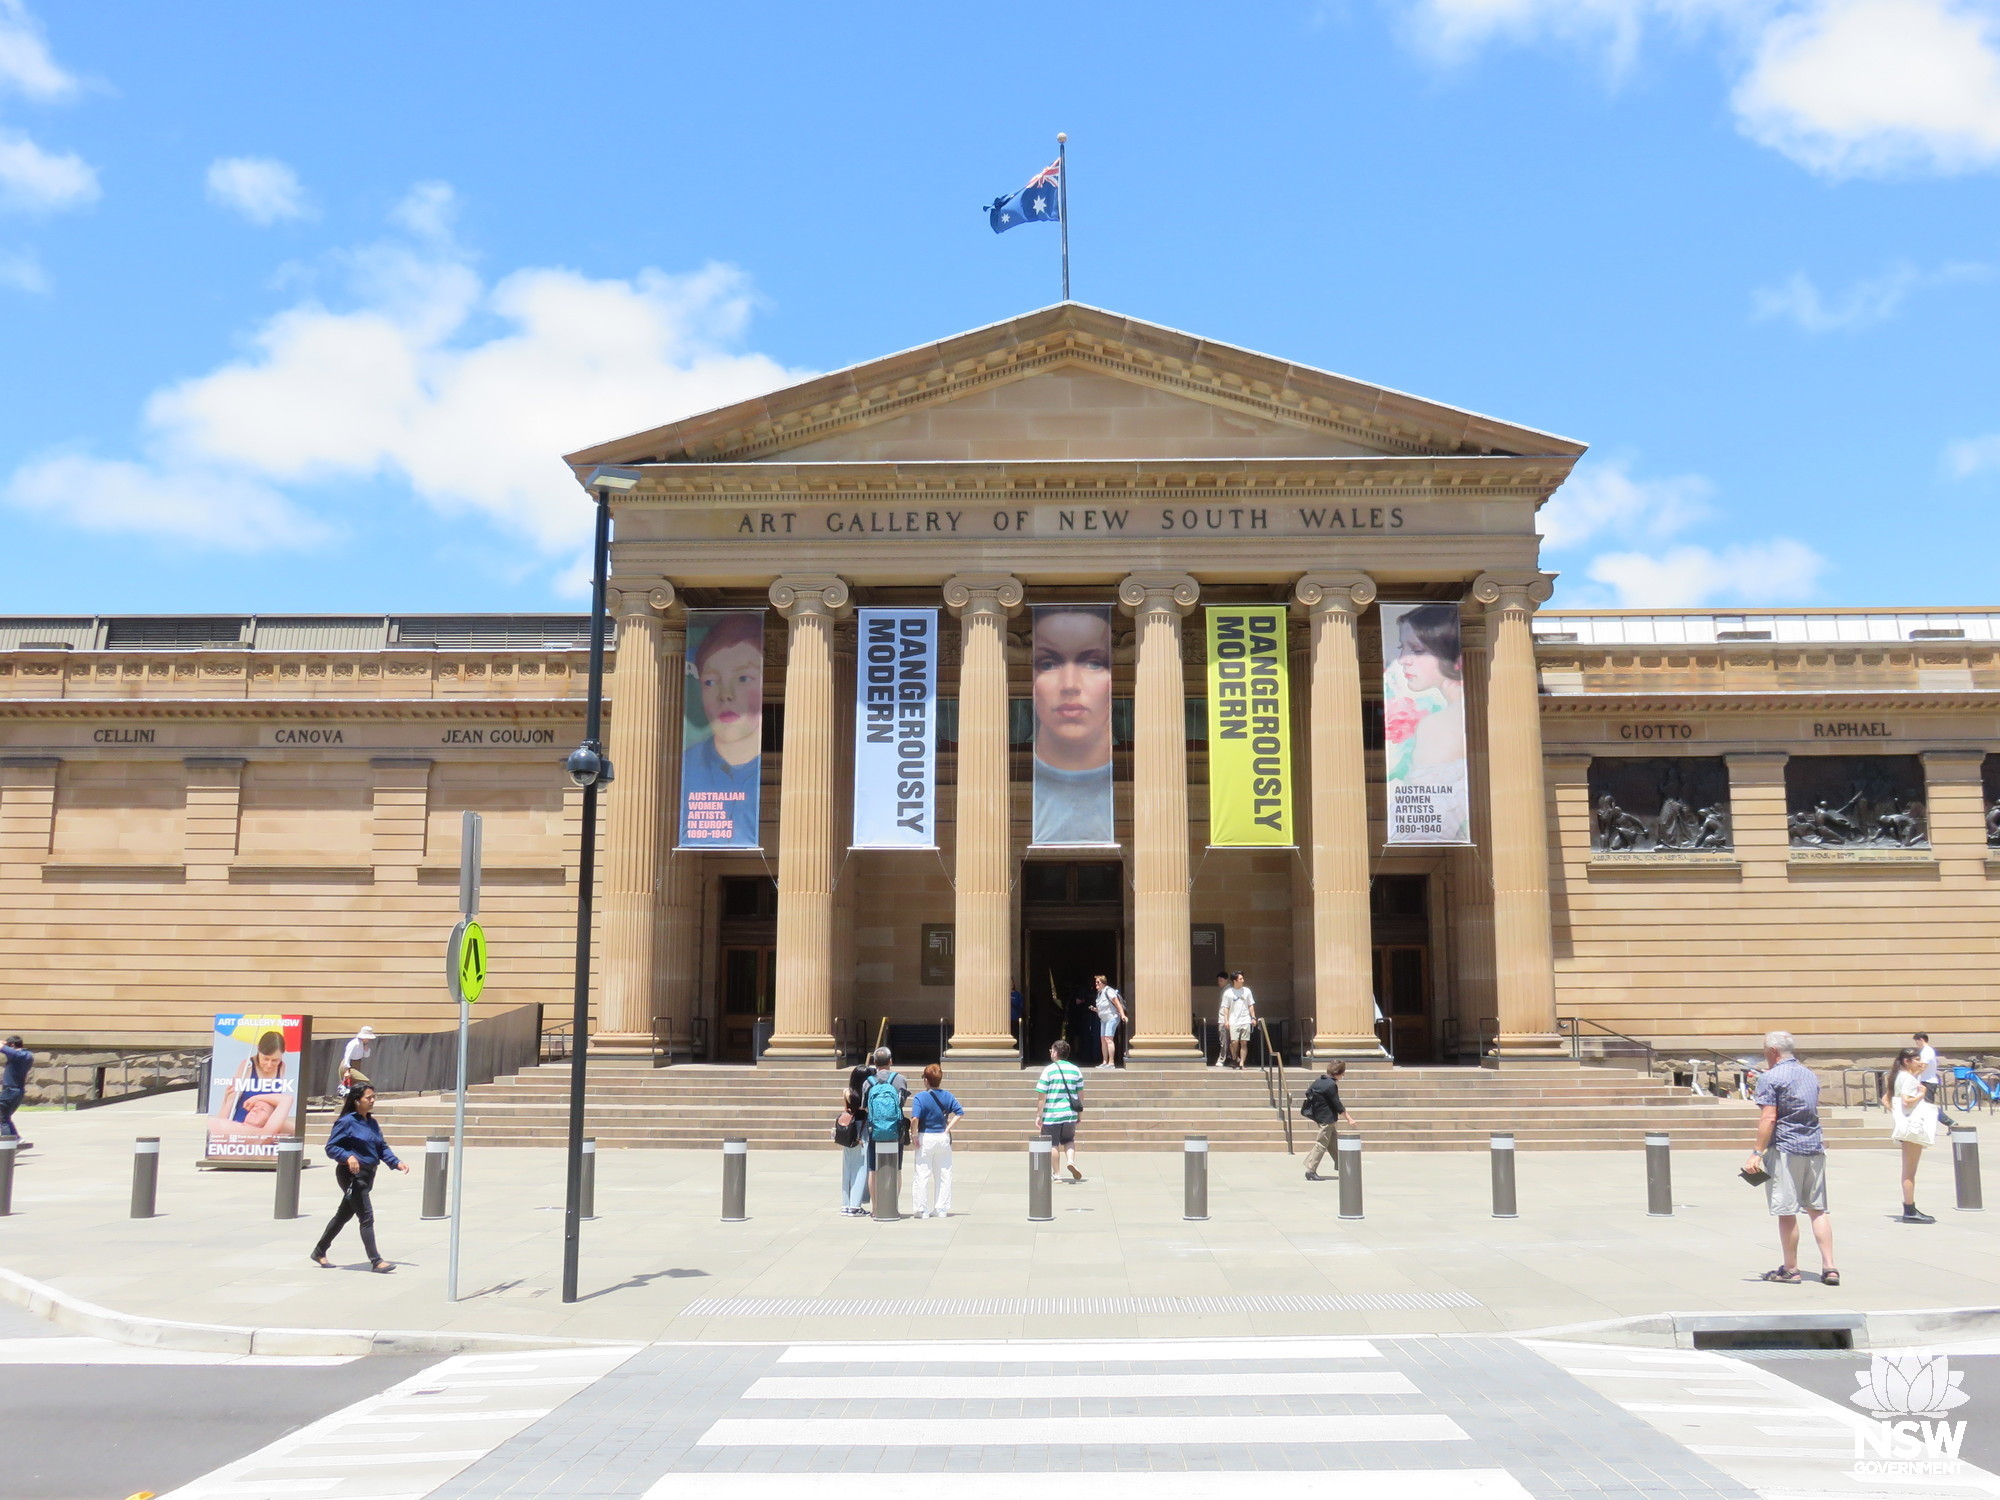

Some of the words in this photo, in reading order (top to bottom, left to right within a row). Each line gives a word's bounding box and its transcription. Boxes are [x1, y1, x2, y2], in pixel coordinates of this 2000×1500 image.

[738, 513, 796, 532] ART
[826, 512, 963, 532] GALLERY
[993, 511, 1029, 531] OF
[1059, 510, 1129, 531] NEW
[1161, 509, 1268, 529] SOUTH
[1299, 508, 1404, 528] WALES
[866, 619, 896, 743] MODERN
[1216, 616, 1248, 740] MODERN
[896, 619, 927, 834] DANGEROUSLY
[1249, 616, 1282, 832] DANGEROUSLY
[1620, 724, 1692, 739] GIOTTO
[1814, 723, 1892, 737] RAPHAEL
[94, 730, 155, 743] CELLINI
[275, 730, 343, 743] CANOVA
[441, 730, 483, 743] JEAN
[490, 730, 554, 743] GOUJON
[1395, 786, 1453, 794] AUSTRALIAN
[688, 792, 745, 801] AUSTRALIAN
[1395, 796, 1431, 804] WOMEN
[688, 802, 724, 810] WOMEN
[1395, 805, 1434, 814] ARTISTS
[688, 811, 726, 820] ARTISTS
[1395, 815, 1405, 823] IN
[1407, 815, 1442, 824] EUROPE
[687, 820, 698, 829] IN
[698, 820, 733, 829] EUROPE
[1396, 824, 1442, 833] 1890-1940
[687, 830, 732, 838] 1890-1940
[277, 1019, 300, 1027] NSW
[213, 1078, 233, 1086] RON
[234, 1079, 294, 1092] MUECK
